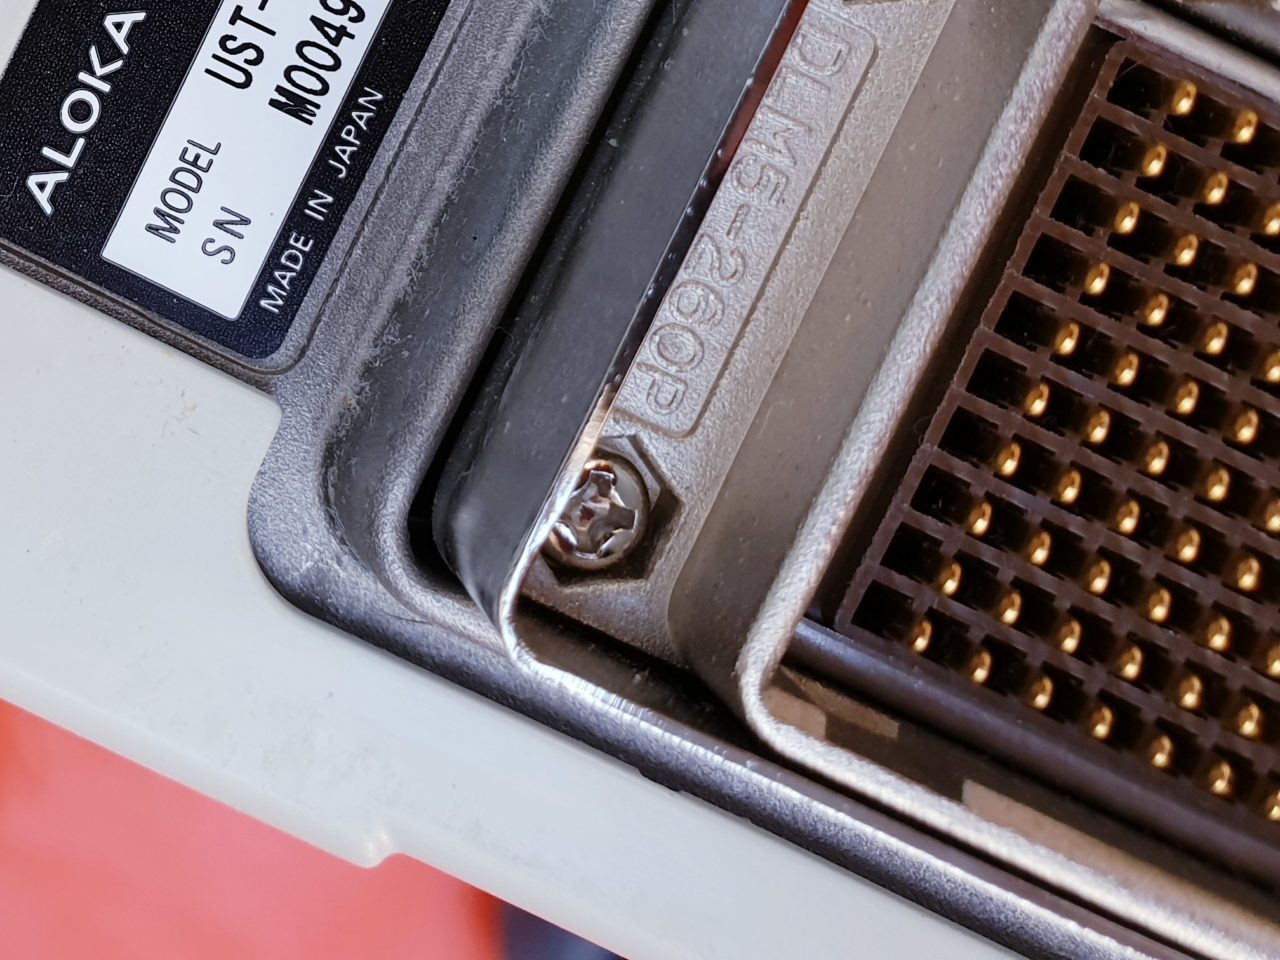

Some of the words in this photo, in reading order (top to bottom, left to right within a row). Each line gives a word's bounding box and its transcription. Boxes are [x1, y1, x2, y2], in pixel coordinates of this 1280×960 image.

[25, 11, 147, 217] ALOKA
[145, 139, 222, 244] MODEL
[259, 231, 314, 314] MADE
[305, 189, 335, 221] IN
[328, 86, 385, 179] JAPAN
